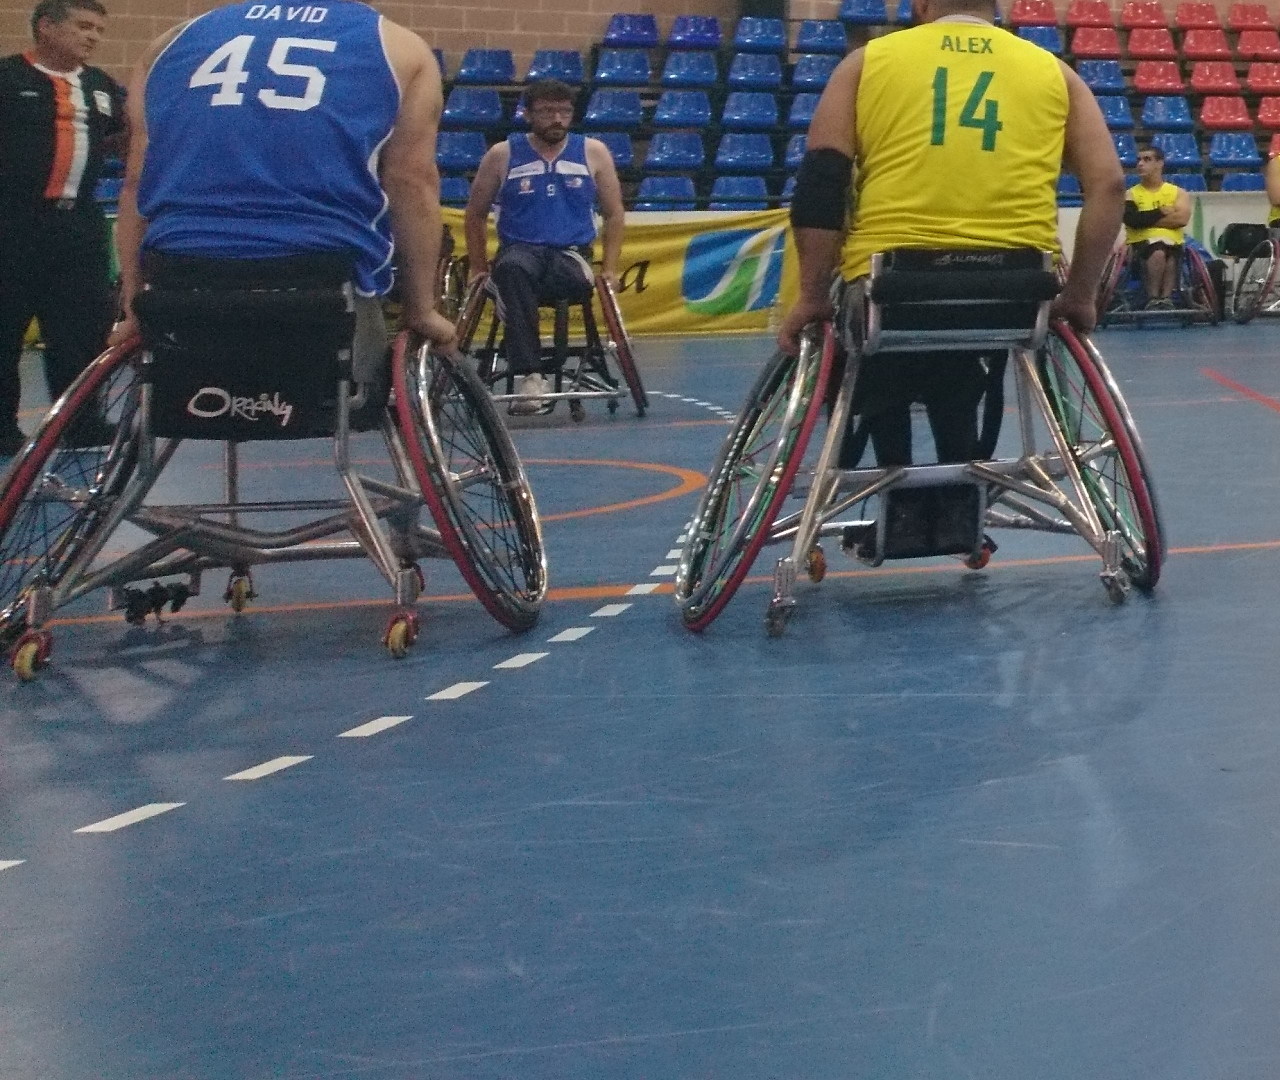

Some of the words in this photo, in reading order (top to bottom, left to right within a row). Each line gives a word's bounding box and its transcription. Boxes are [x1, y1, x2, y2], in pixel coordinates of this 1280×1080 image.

[244, 4, 328, 23] DAVID
[941, 35, 993, 54] ALEX
[189, 35, 337, 111] 45
[930, 66, 1003, 152] 14
